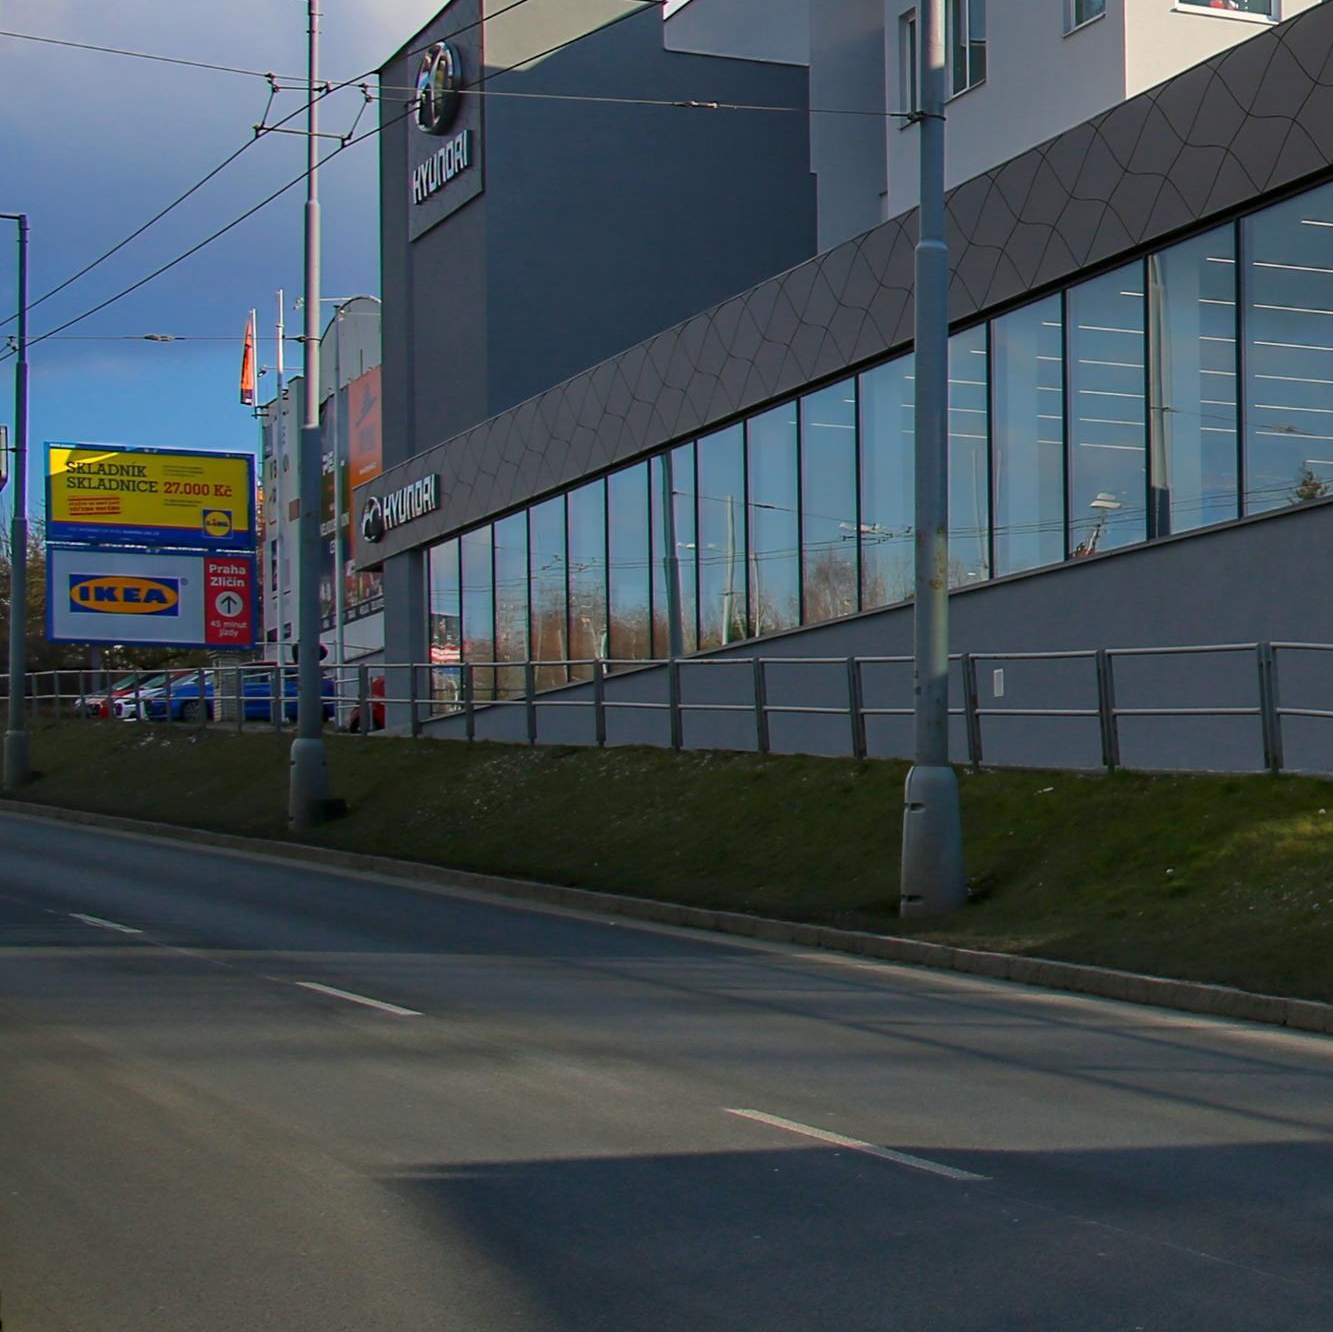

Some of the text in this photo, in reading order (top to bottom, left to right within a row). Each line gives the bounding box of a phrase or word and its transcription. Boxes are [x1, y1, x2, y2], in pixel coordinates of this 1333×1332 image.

[413, 129, 471, 205] HYUNDAI
[66, 461, 147, 478] SKLADNÍK
[66, 476, 158, 493] SKLADNICE
[163, 481, 232, 497] 27.000 Kč
[383, 473, 437, 530] HYUNDAI
[209, 563, 246, 575] Praha
[210, 576, 245, 587] Zličín
[79, 586, 168, 604] IKEA
